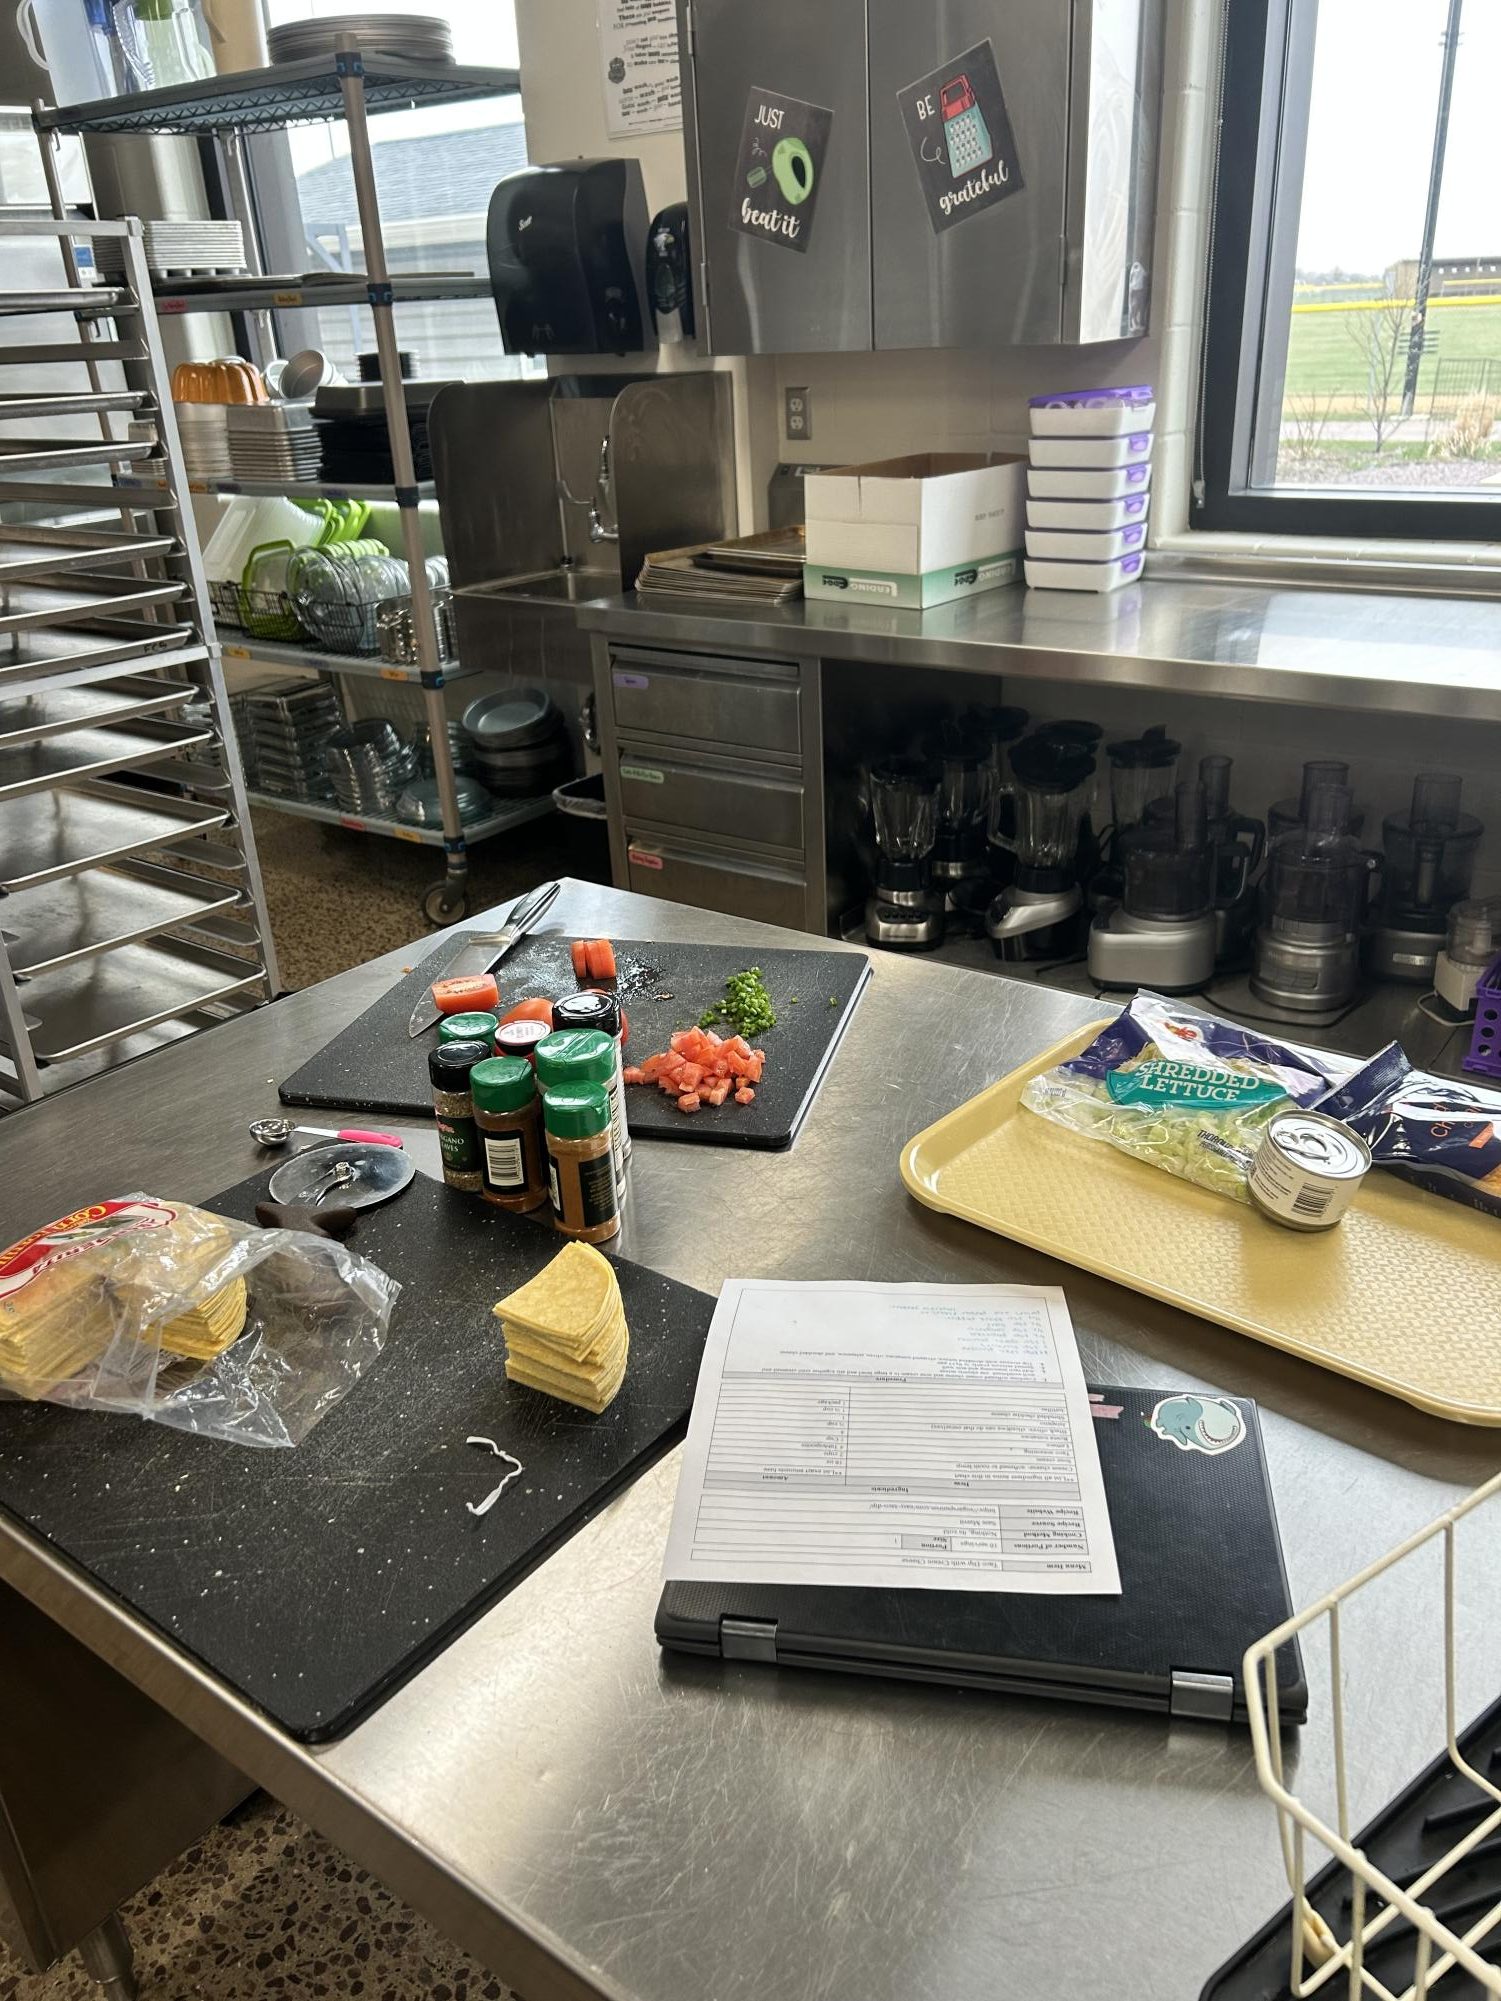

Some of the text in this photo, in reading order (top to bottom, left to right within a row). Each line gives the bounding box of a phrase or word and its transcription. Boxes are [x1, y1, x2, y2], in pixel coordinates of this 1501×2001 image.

[754, 105, 785, 129] JUST
[916, 95, 936, 120] BE
[939, 160, 1009, 215] grateful
[741, 197, 800, 237] beat it
[1136, 1059, 1260, 1090] SHREDDED
[1139, 1074, 1241, 1101] LETTUCE
[1045, 1561, 1087, 1571] Menu Item
